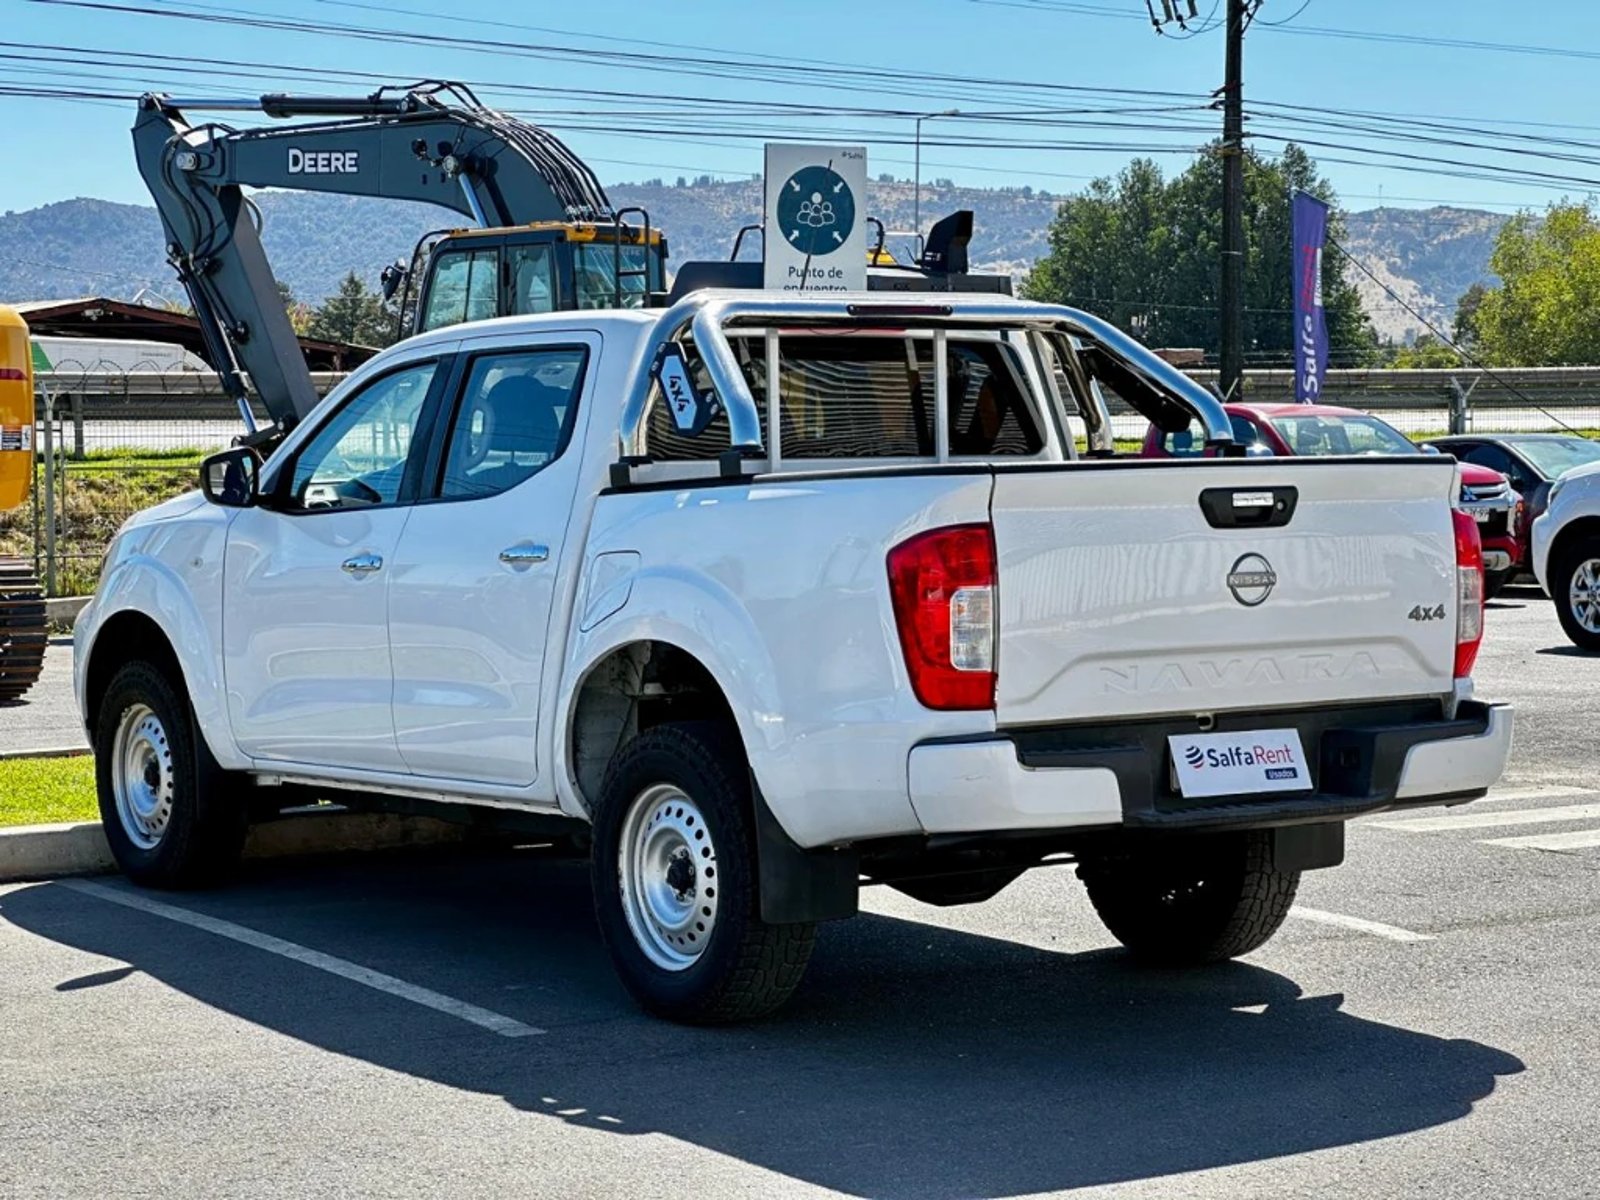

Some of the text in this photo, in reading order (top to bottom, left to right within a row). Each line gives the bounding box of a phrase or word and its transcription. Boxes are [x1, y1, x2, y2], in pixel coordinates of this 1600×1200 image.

[788, 266, 843, 279] Punto de
[1230, 575, 1275, 585] NISSAN
[1099, 651, 1383, 695] NAVARA
[1207, 744, 1294, 768] SalfaRent
